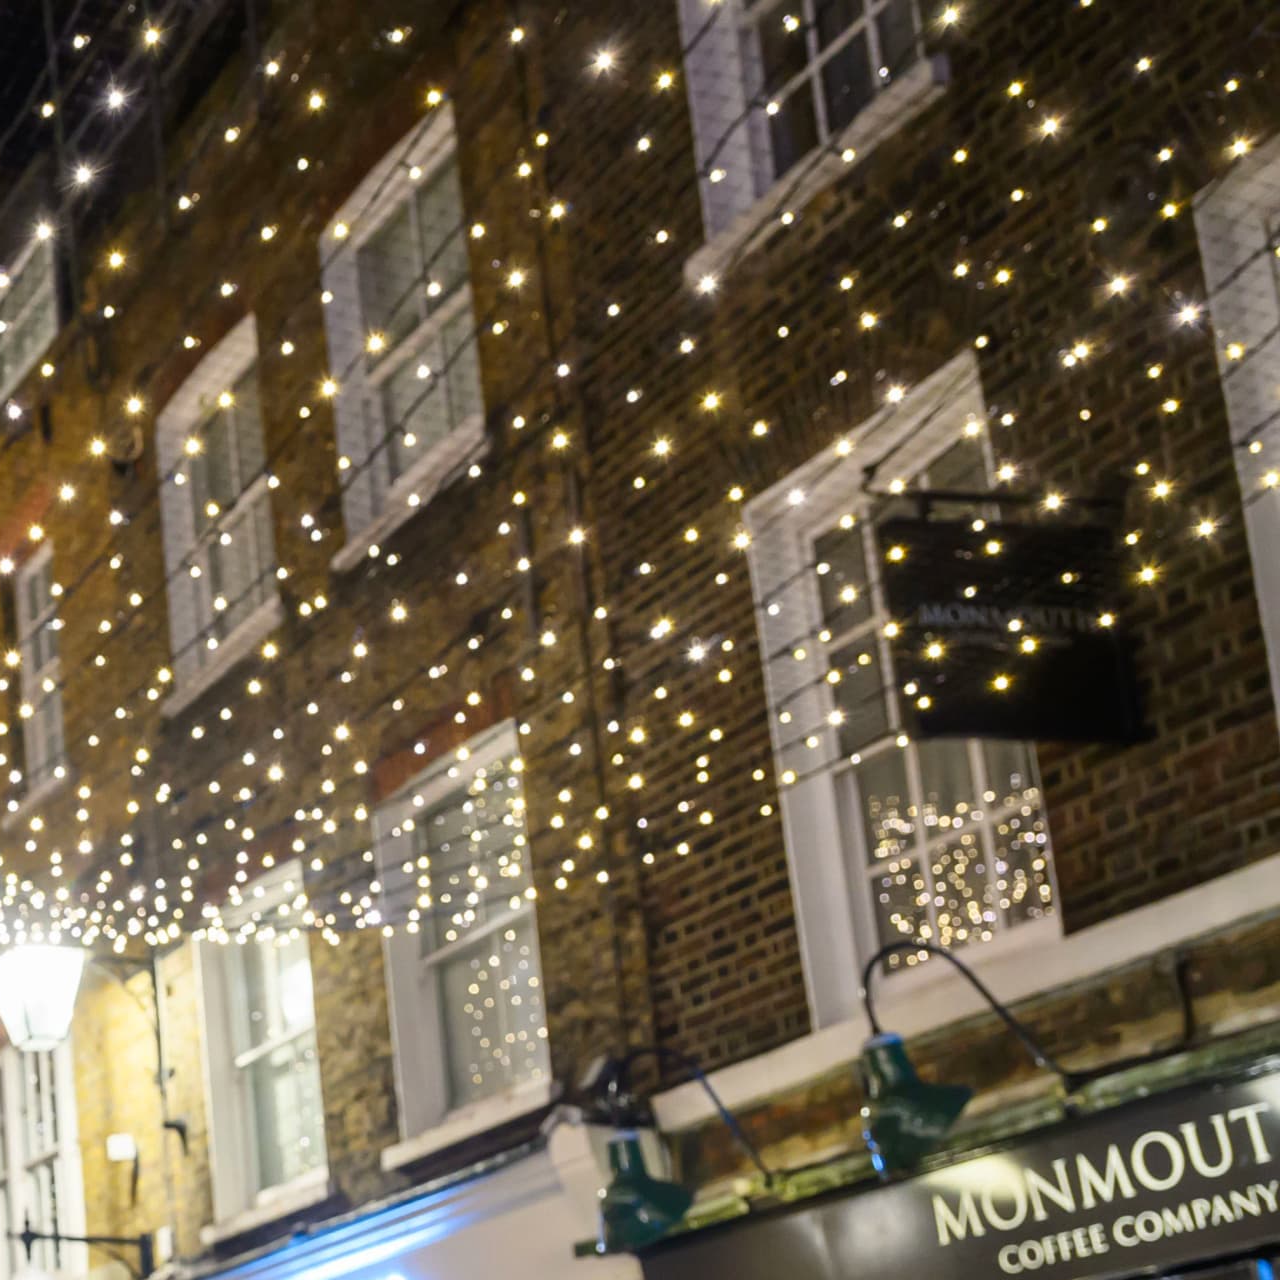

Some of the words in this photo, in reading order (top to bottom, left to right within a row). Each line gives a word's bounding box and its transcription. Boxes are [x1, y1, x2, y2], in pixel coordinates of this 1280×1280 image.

[931, 1102, 1273, 1247] MONMOUT
[997, 1222, 1110, 1275] COFFEE
[1112, 1180, 1280, 1248] COMPANY
